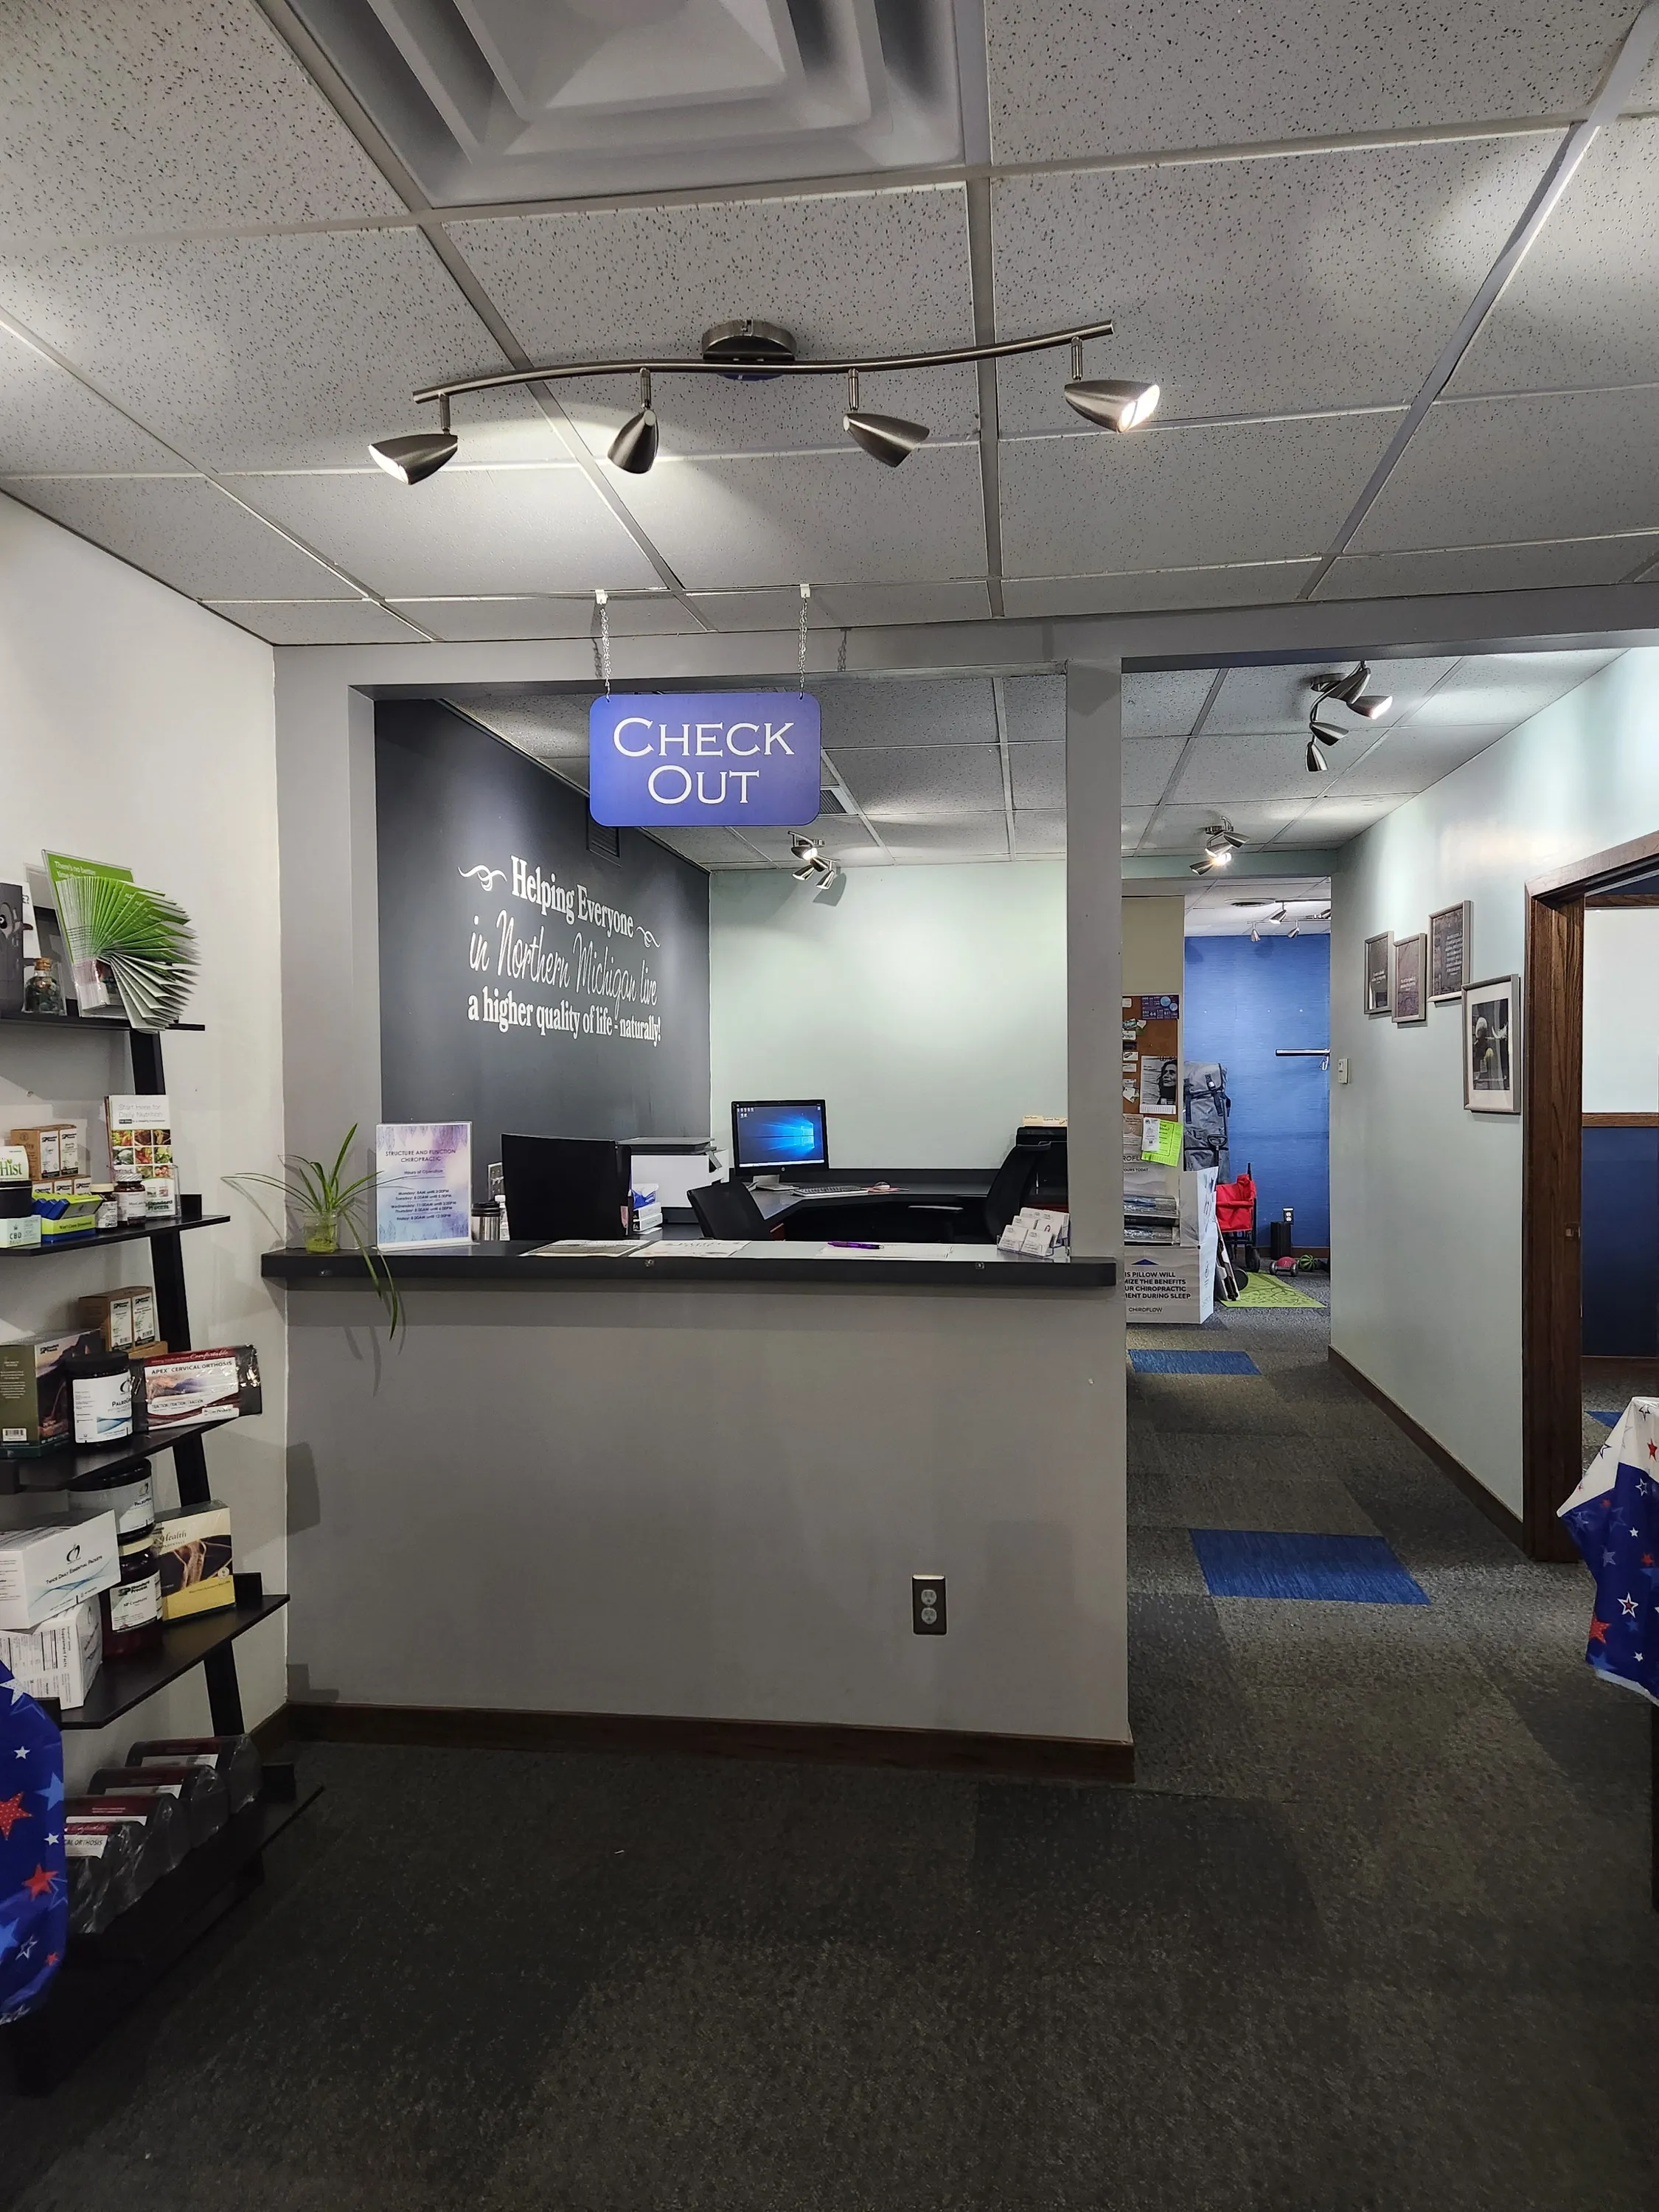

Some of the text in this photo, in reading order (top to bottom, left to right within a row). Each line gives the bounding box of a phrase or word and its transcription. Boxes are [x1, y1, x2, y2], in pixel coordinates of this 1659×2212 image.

[613, 717, 795, 757] CHECK
[647, 765, 759, 804] OUT
[510, 855, 635, 938] Helping Everyone
[469, 909, 657, 1020] in Northern Michigan live
[467, 995, 479, 1021] a
[482, 985, 534, 1033] higher
[536, 1000, 580, 1039] quality
[582, 1005, 596, 1033] of
[596, 1005, 613, 1035] life
[619, 1015, 661, 1047] naturally!
[9, 1231, 22, 1239] CBD
[201, 1360, 232, 1368] ORTHOSIS
